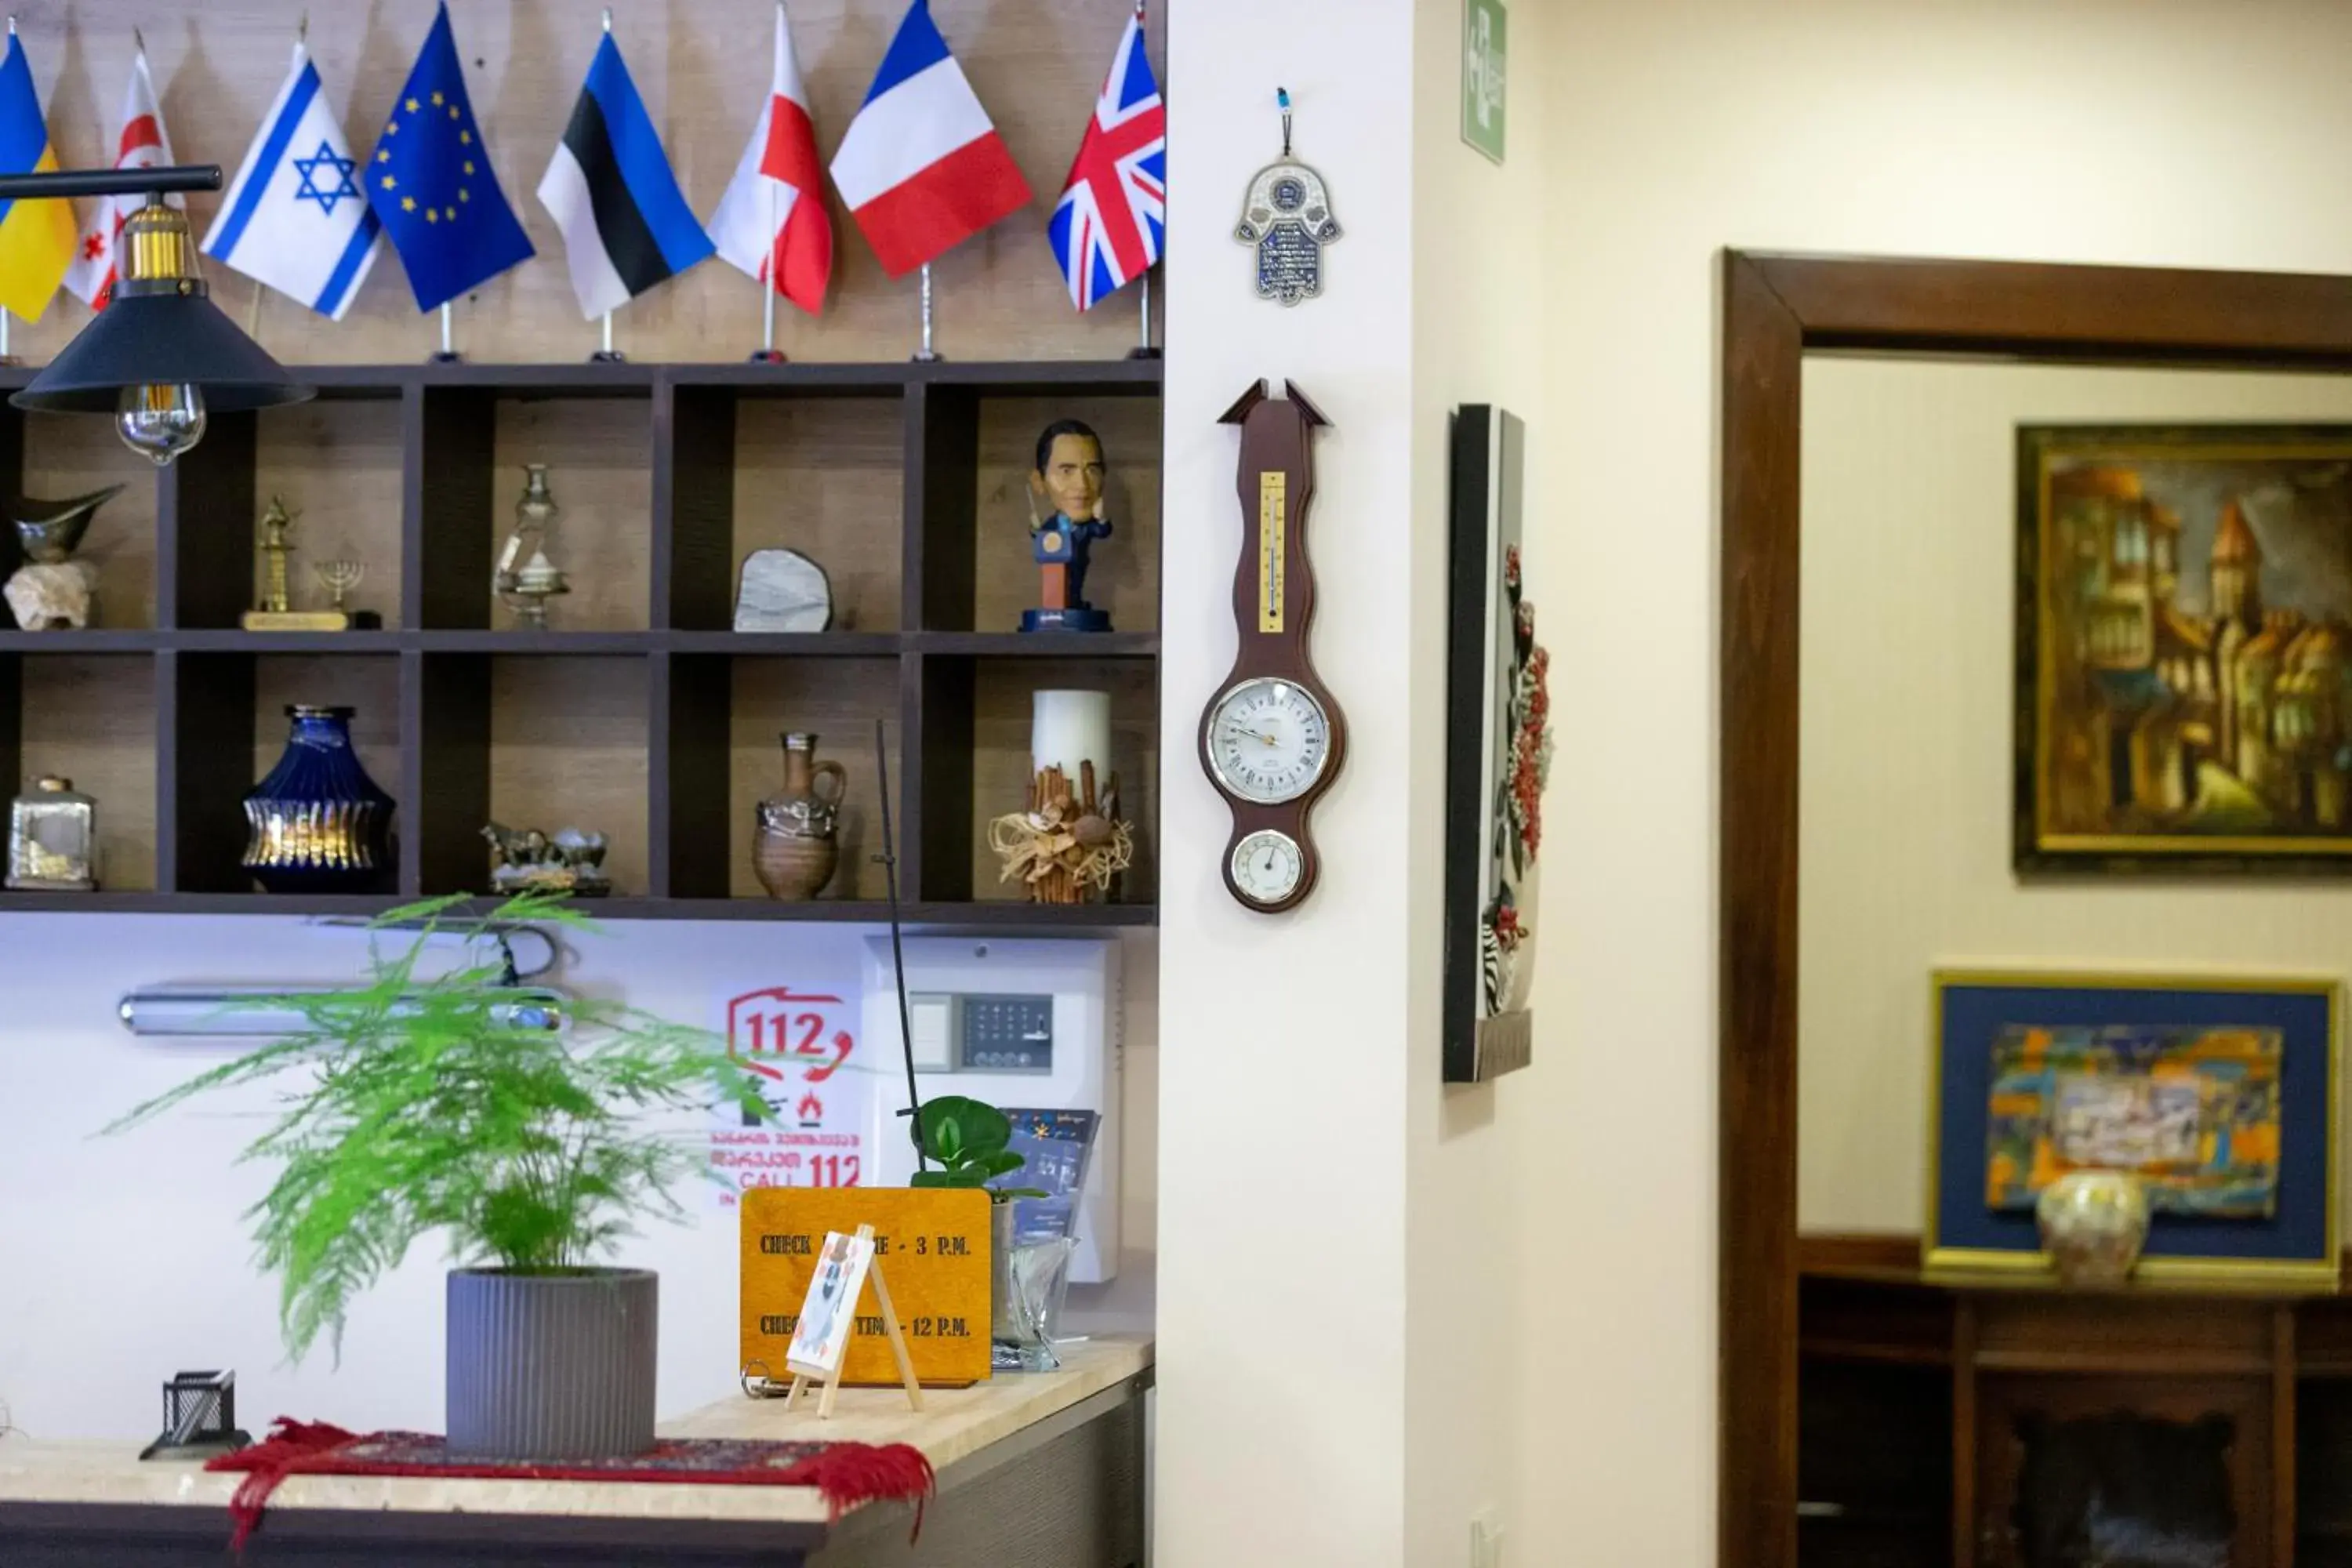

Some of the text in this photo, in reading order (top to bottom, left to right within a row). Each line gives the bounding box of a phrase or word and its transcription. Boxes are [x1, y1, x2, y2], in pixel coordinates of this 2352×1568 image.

[746, 1012, 826, 1054] 112
[809, 1153, 860, 1188] 112
[760, 1235, 811, 1255] CHECK
[916, 1236, 927, 1255] 3
[937, 1236, 971, 1256] P.M.
[913, 1316, 932, 1337] 12
[937, 1316, 971, 1337] P.M.
